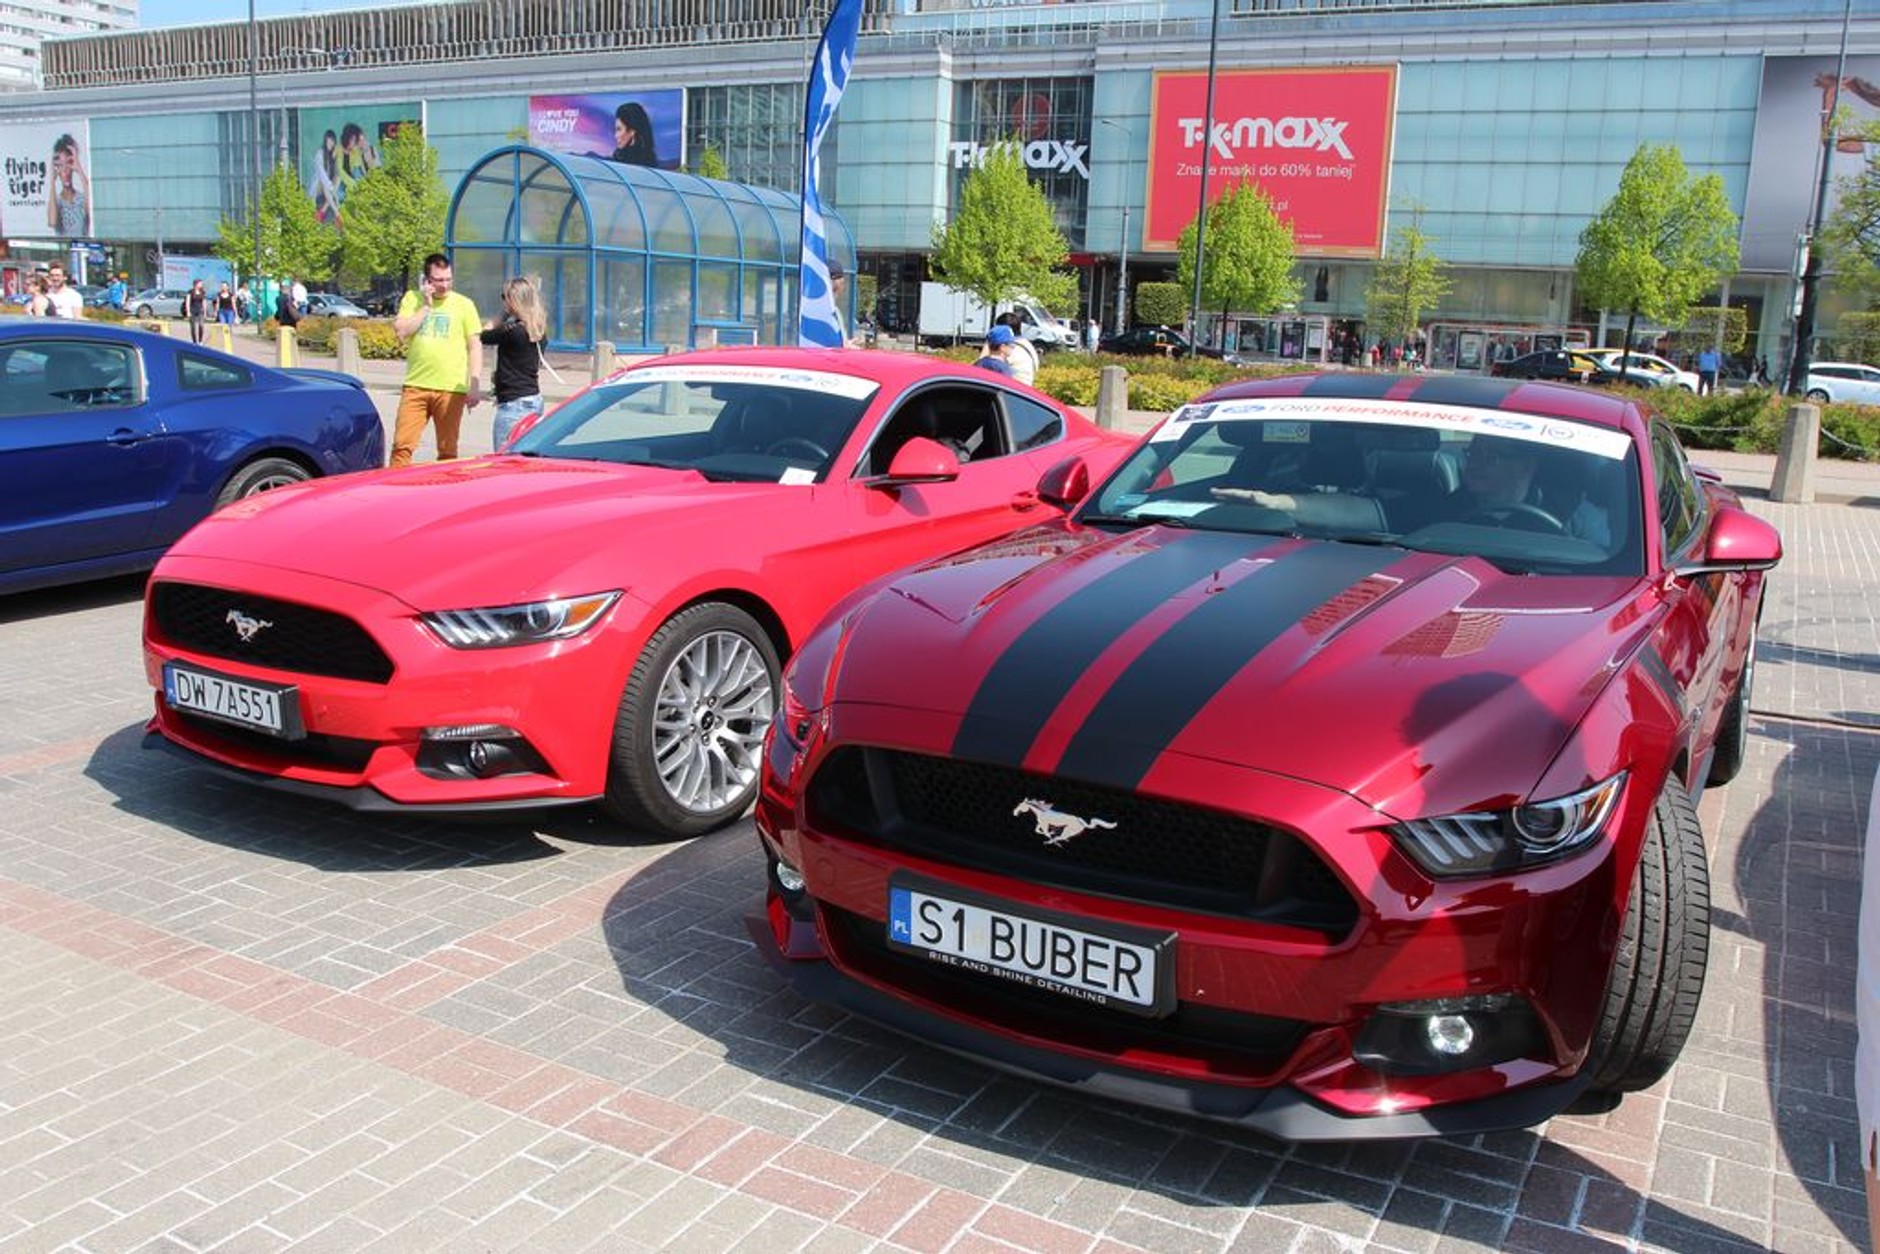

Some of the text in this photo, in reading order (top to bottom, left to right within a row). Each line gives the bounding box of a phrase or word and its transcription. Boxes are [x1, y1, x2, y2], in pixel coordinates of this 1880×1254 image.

[537, 118, 578, 133] CINDY
[5, 156, 46, 179] flying
[1176, 163, 1217, 177] Znae
[1259, 163, 1277, 177] do
[1280, 163, 1312, 177] 60%
[9, 178, 45, 199] tiger
[1268, 403, 1321, 413] FORD
[1321, 404, 1477, 424] PERFORMANCE
[176, 671, 276, 726] DW 7A551
[893, 919, 910, 935] PL
[918, 899, 1142, 998] S1 BUBER
[929, 951, 1108, 1006] RISE AND SHINE DETAILING
